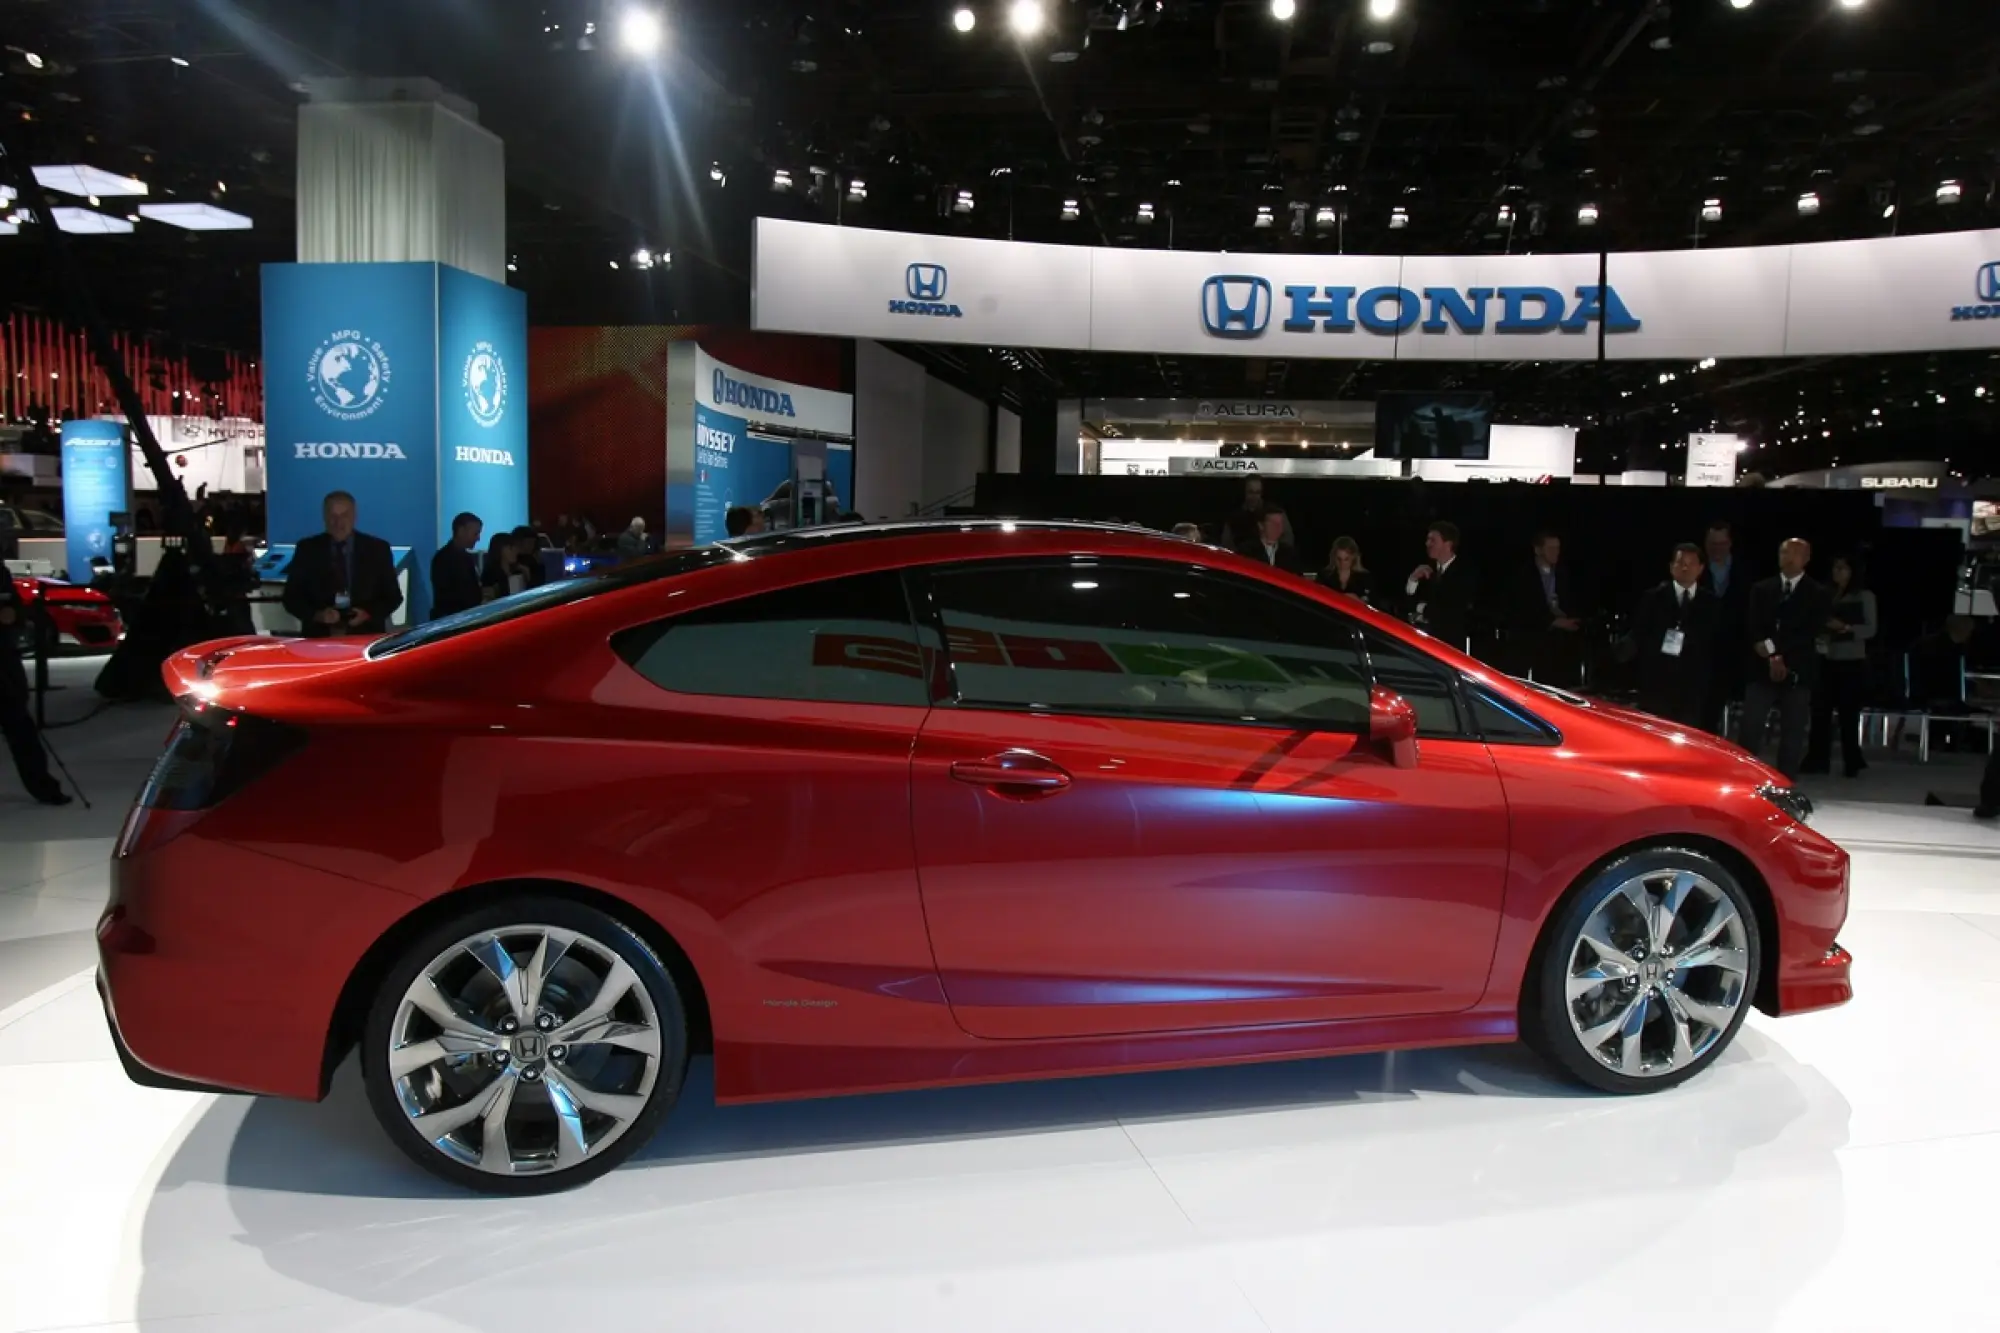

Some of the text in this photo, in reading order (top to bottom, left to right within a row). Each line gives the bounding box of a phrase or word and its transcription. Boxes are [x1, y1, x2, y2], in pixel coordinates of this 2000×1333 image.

[889, 299, 963, 317] HONDA
[1282, 285, 1641, 335] HONDA
[306, 329, 392, 383] Value MPG Safety
[724, 376, 796, 417] HONDA
[314, 395, 384, 421] Environment
[1215, 404, 1295, 417] ACURA
[294, 442, 407, 459] HONDA
[455, 445, 515, 466] HONDA
[1203, 460, 1259, 471] ACURA
[1860, 477, 1938, 488] SUBARU
